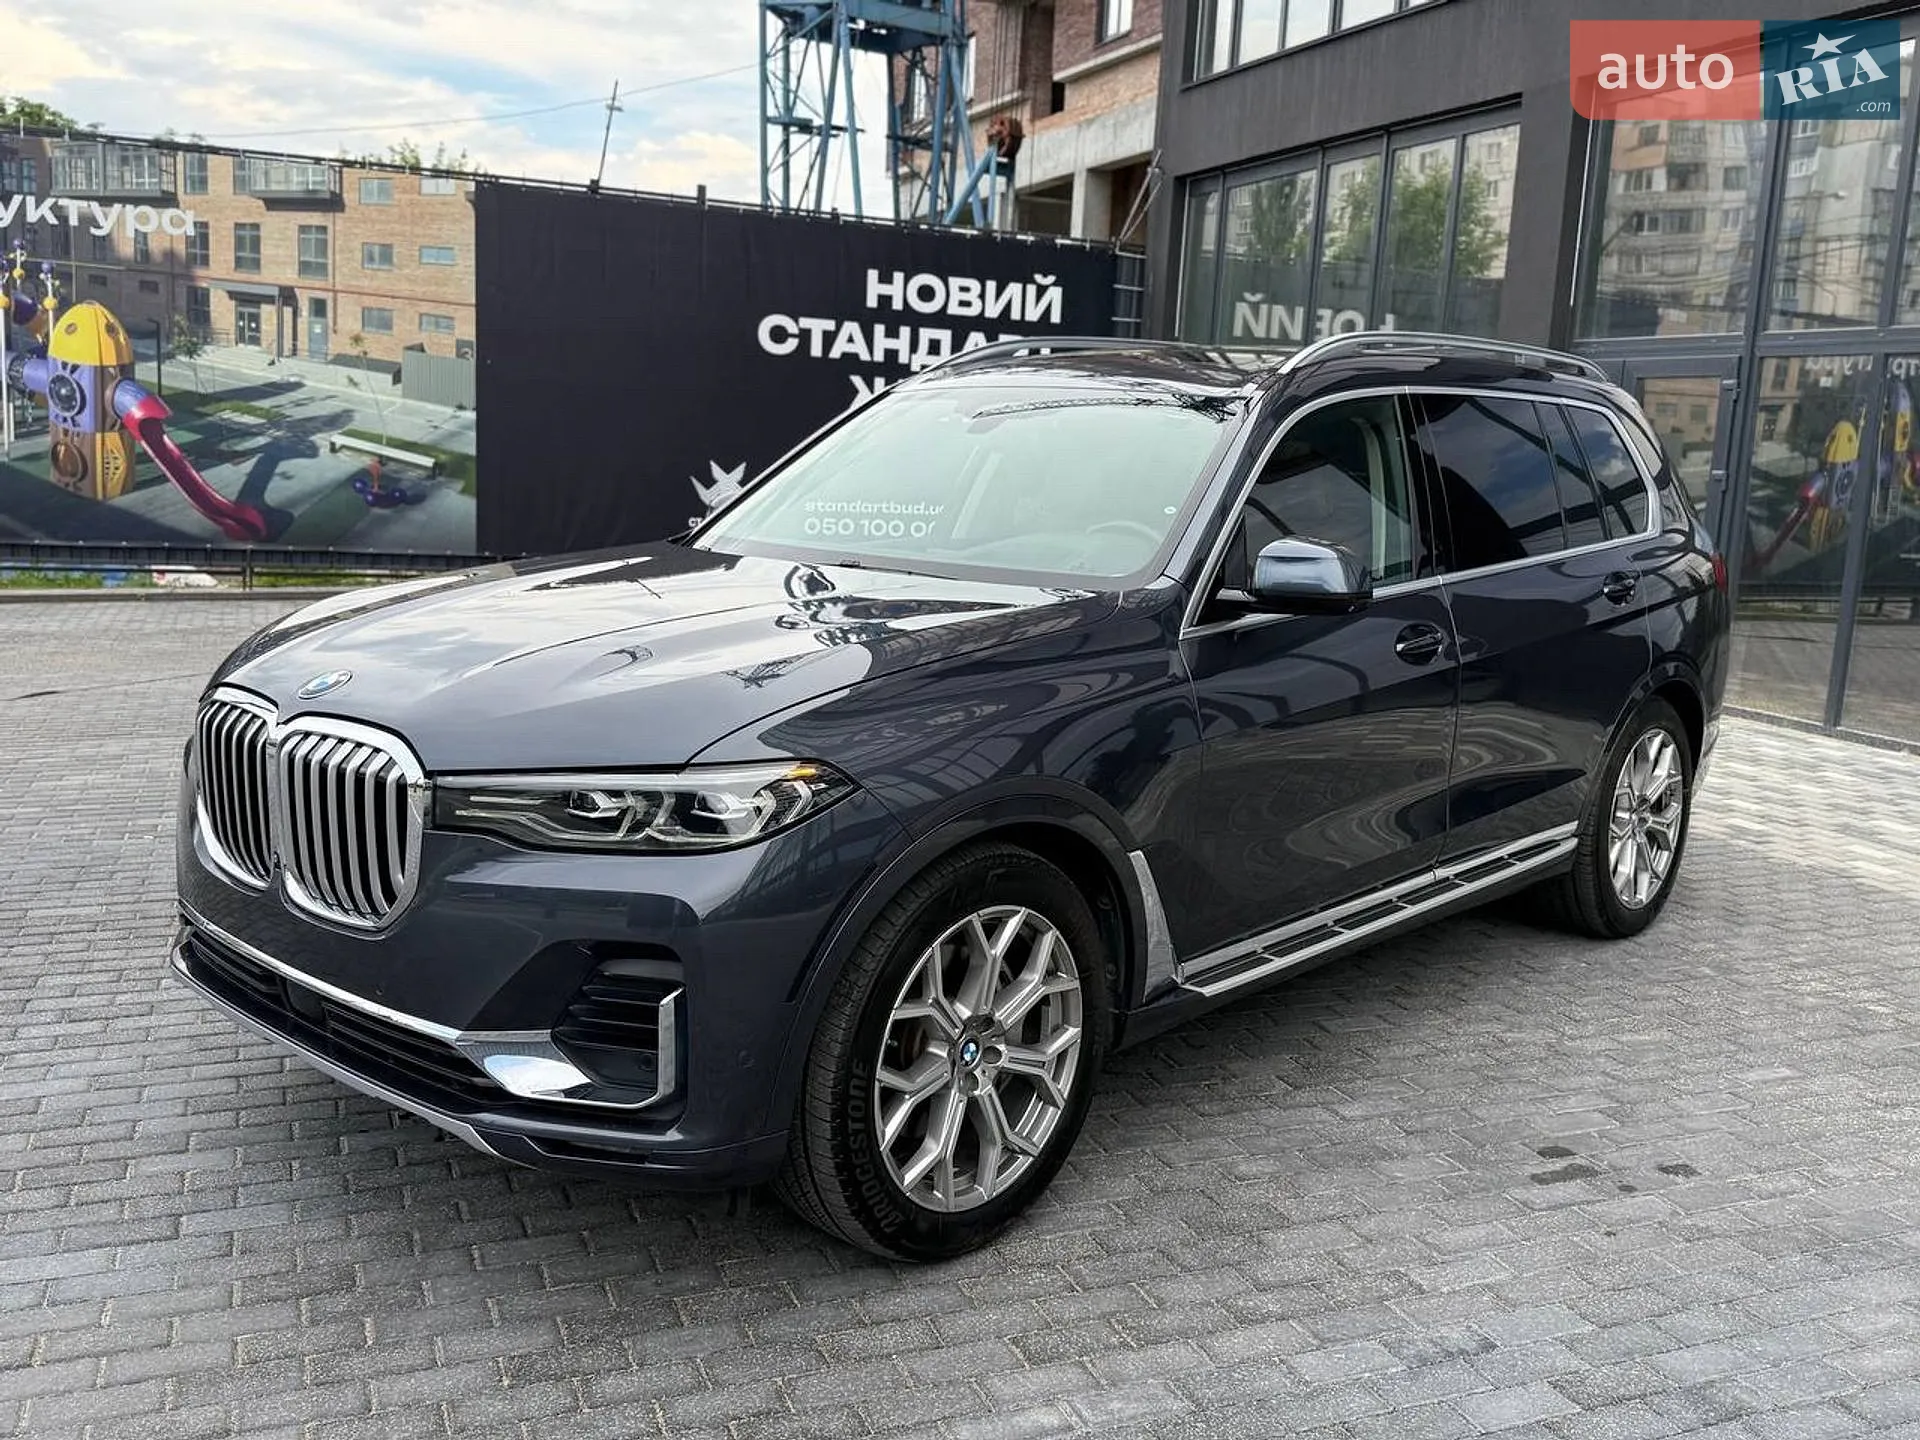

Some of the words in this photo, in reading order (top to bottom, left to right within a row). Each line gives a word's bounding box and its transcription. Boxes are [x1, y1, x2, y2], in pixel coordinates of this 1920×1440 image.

[866, 268, 1063, 324] НОВИЙ
[804, 517, 855, 536] 050
[860, 519, 906, 537] 100
